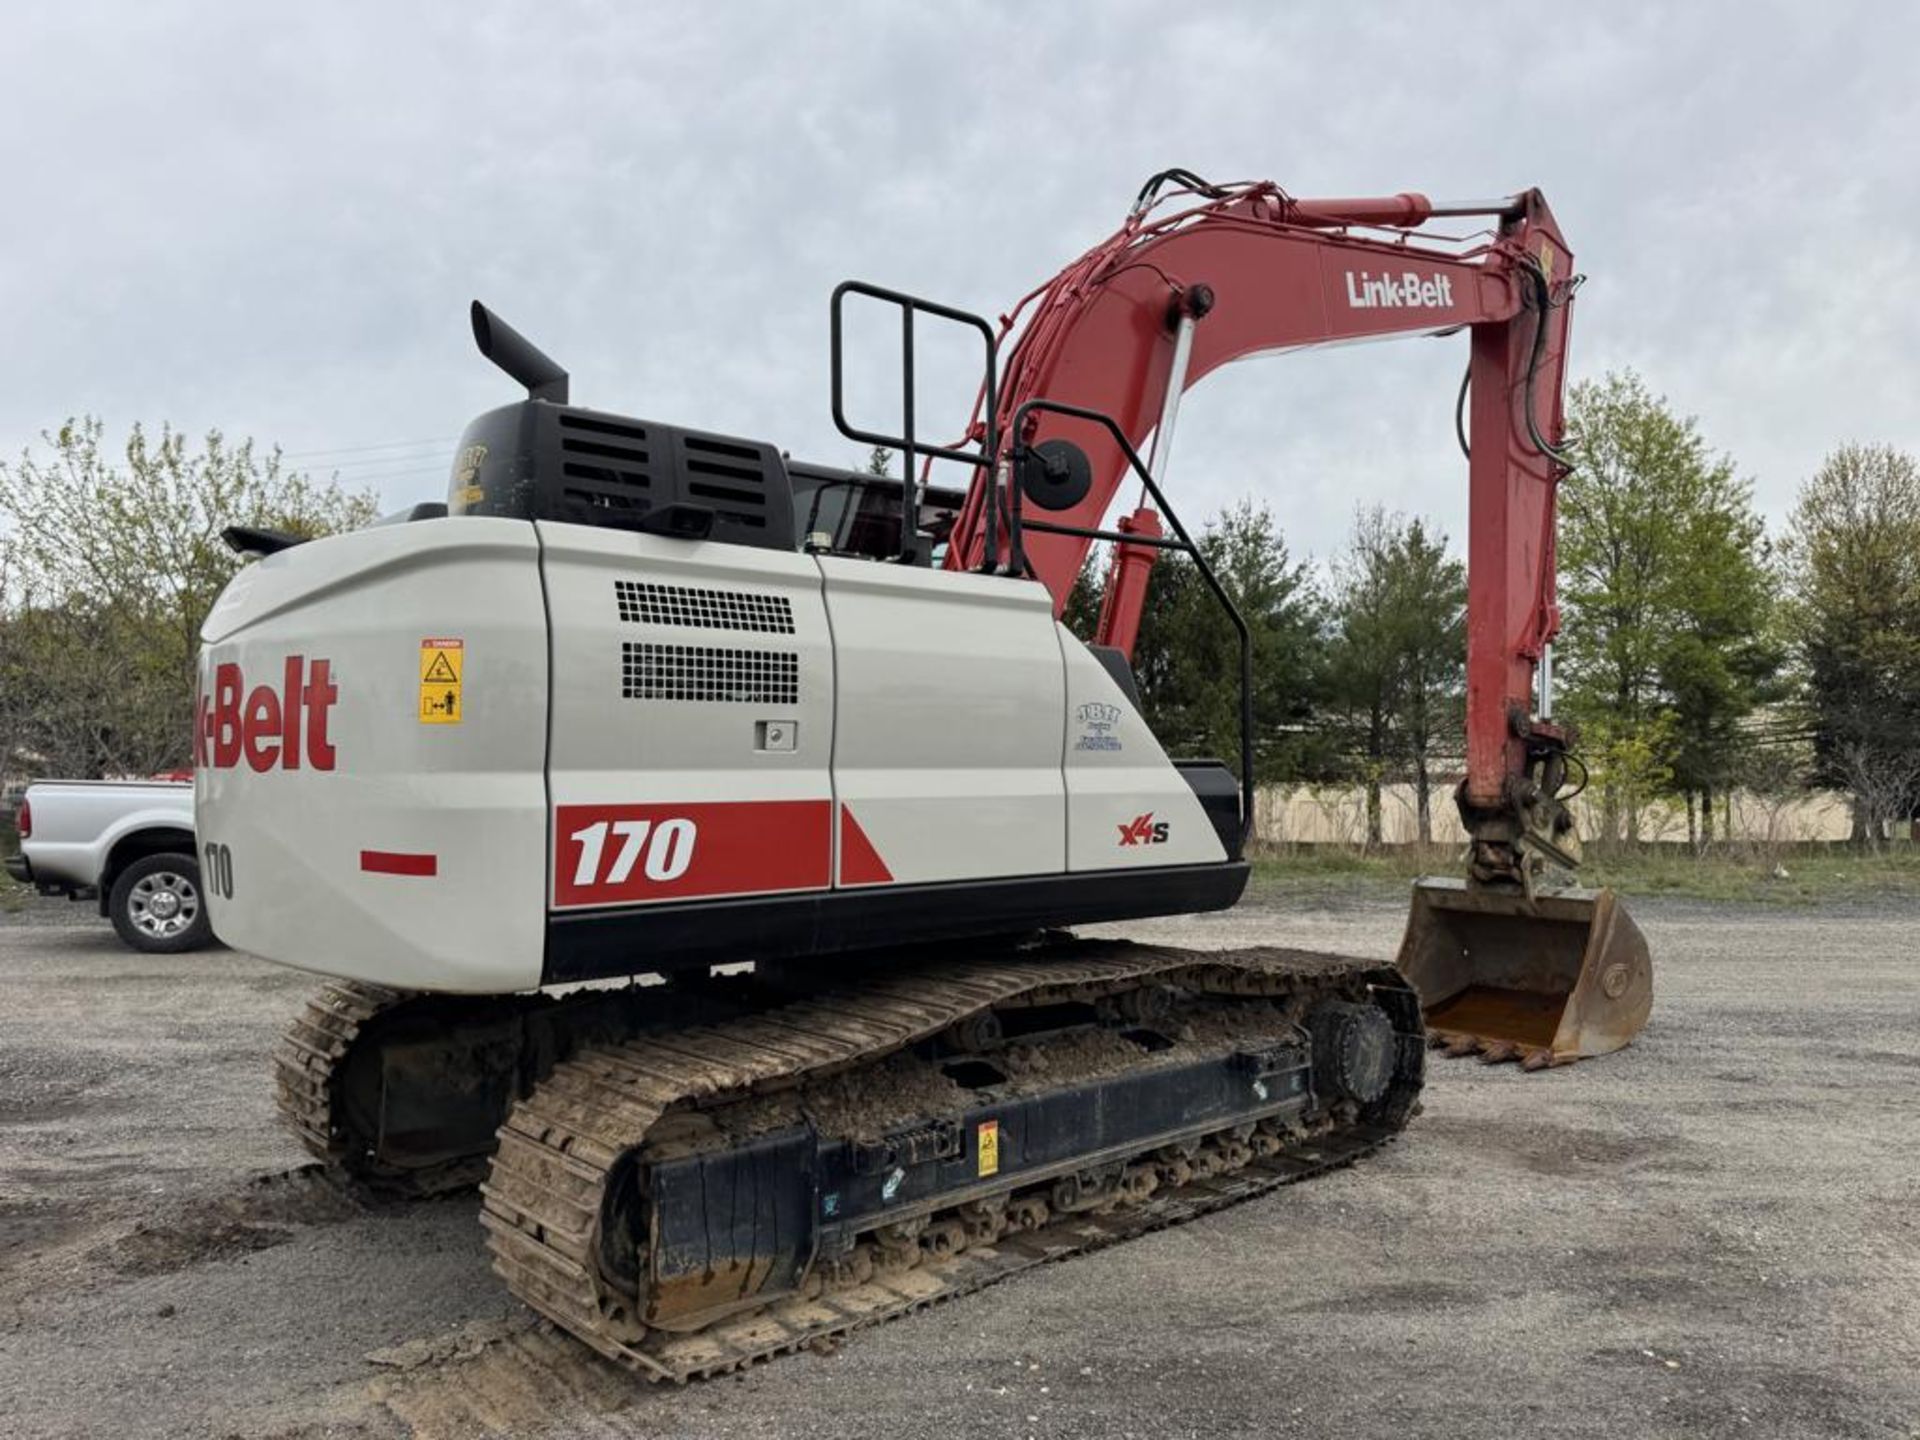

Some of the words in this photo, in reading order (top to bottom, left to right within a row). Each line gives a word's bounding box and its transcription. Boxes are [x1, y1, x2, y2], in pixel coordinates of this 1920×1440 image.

[1345, 271, 1454, 308] Link-Belt
[205, 841, 233, 900] 170
[571, 818, 697, 886] 170
